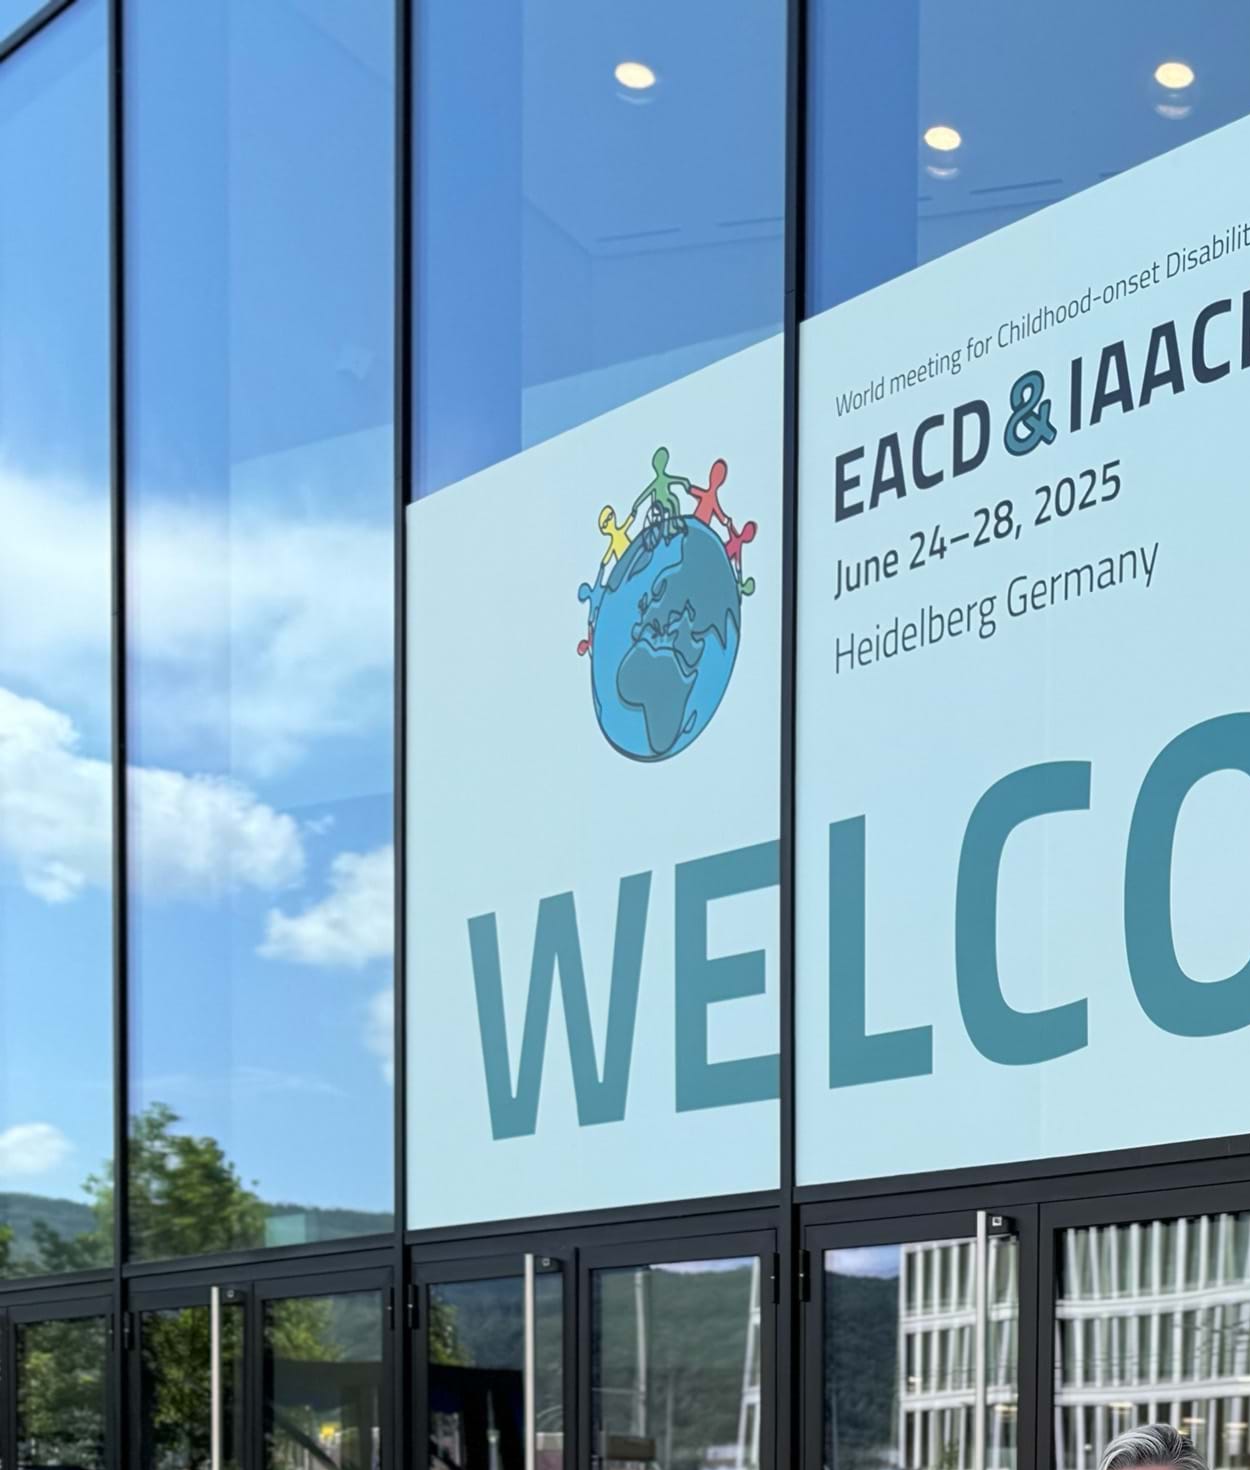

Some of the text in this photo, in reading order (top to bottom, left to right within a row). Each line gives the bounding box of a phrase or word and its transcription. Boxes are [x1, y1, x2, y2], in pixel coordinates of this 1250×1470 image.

[836, 376, 884, 416] World
[890, 349, 961, 394] meeting
[967, 336, 992, 361] for
[998, 262, 1160, 347] Childhood-onset
[835, 400, 990, 523] EACD
[1004, 370, 1057, 456] &
[834, 550, 898, 600] June
[1035, 460, 1120, 526] 2025
[836, 542, 1159, 674] Heidelberg Germany
